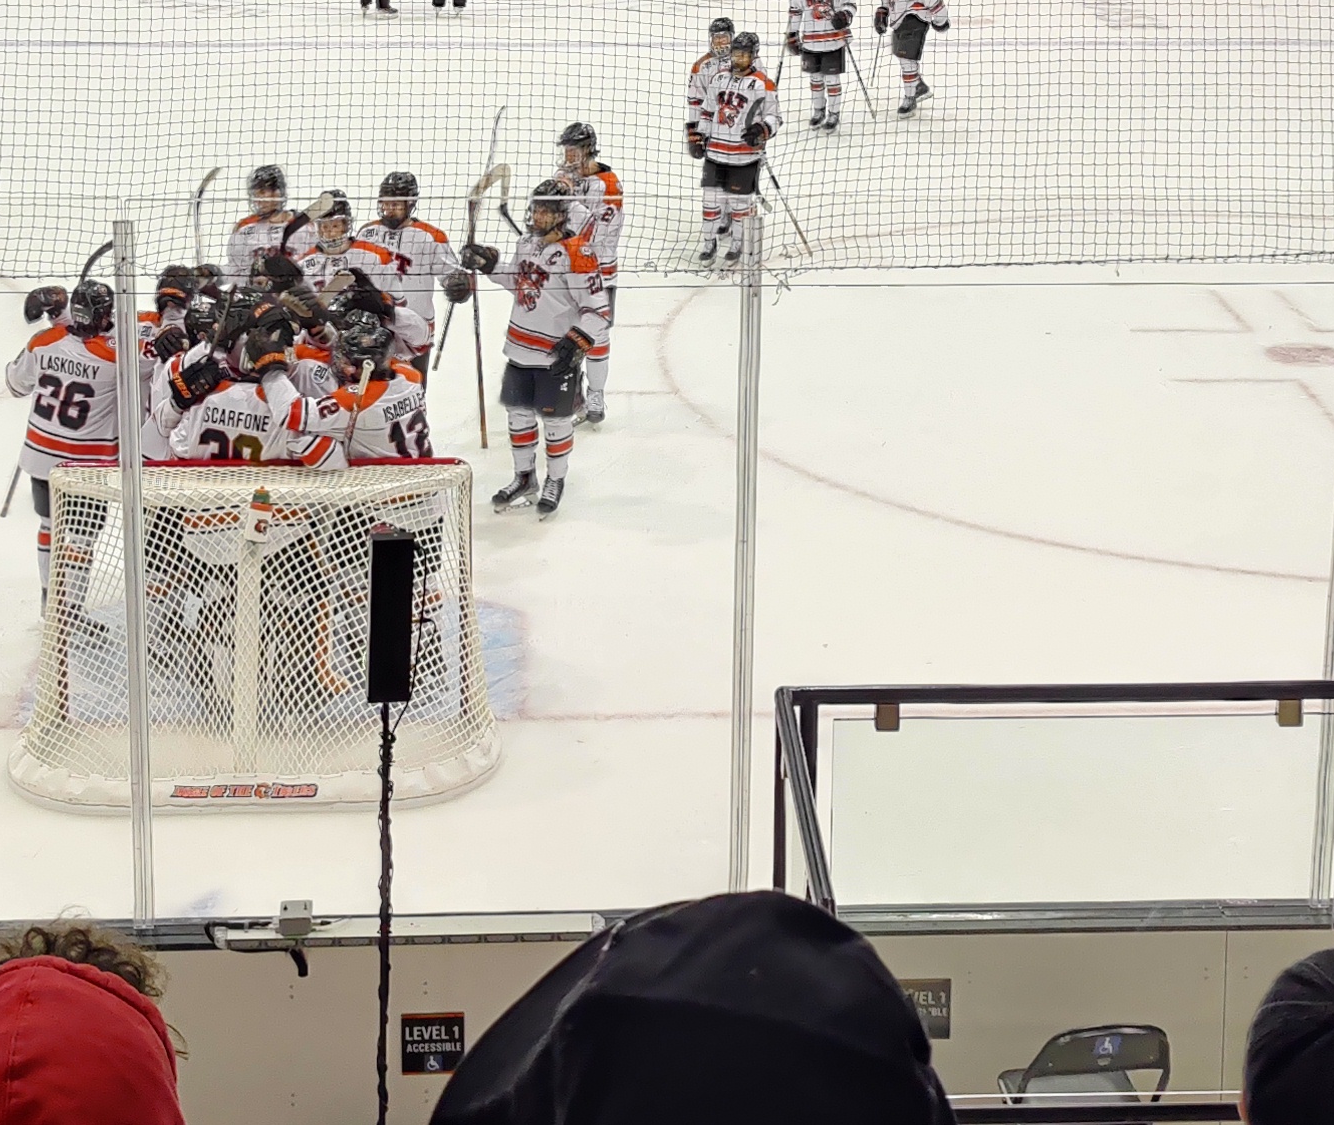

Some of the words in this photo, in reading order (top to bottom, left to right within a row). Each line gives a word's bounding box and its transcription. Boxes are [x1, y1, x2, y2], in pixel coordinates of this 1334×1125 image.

[40, 354, 101, 380] LASKOSKY
[34, 373, 96, 431] 26
[203, 406, 271, 433] SCARFONE
[939, 991, 946, 1004] 1
[405, 1025, 449, 1041] LEVEL
[452, 1025, 459, 1040] 1
[406, 1042, 461, 1054] ACCESSIBLE
